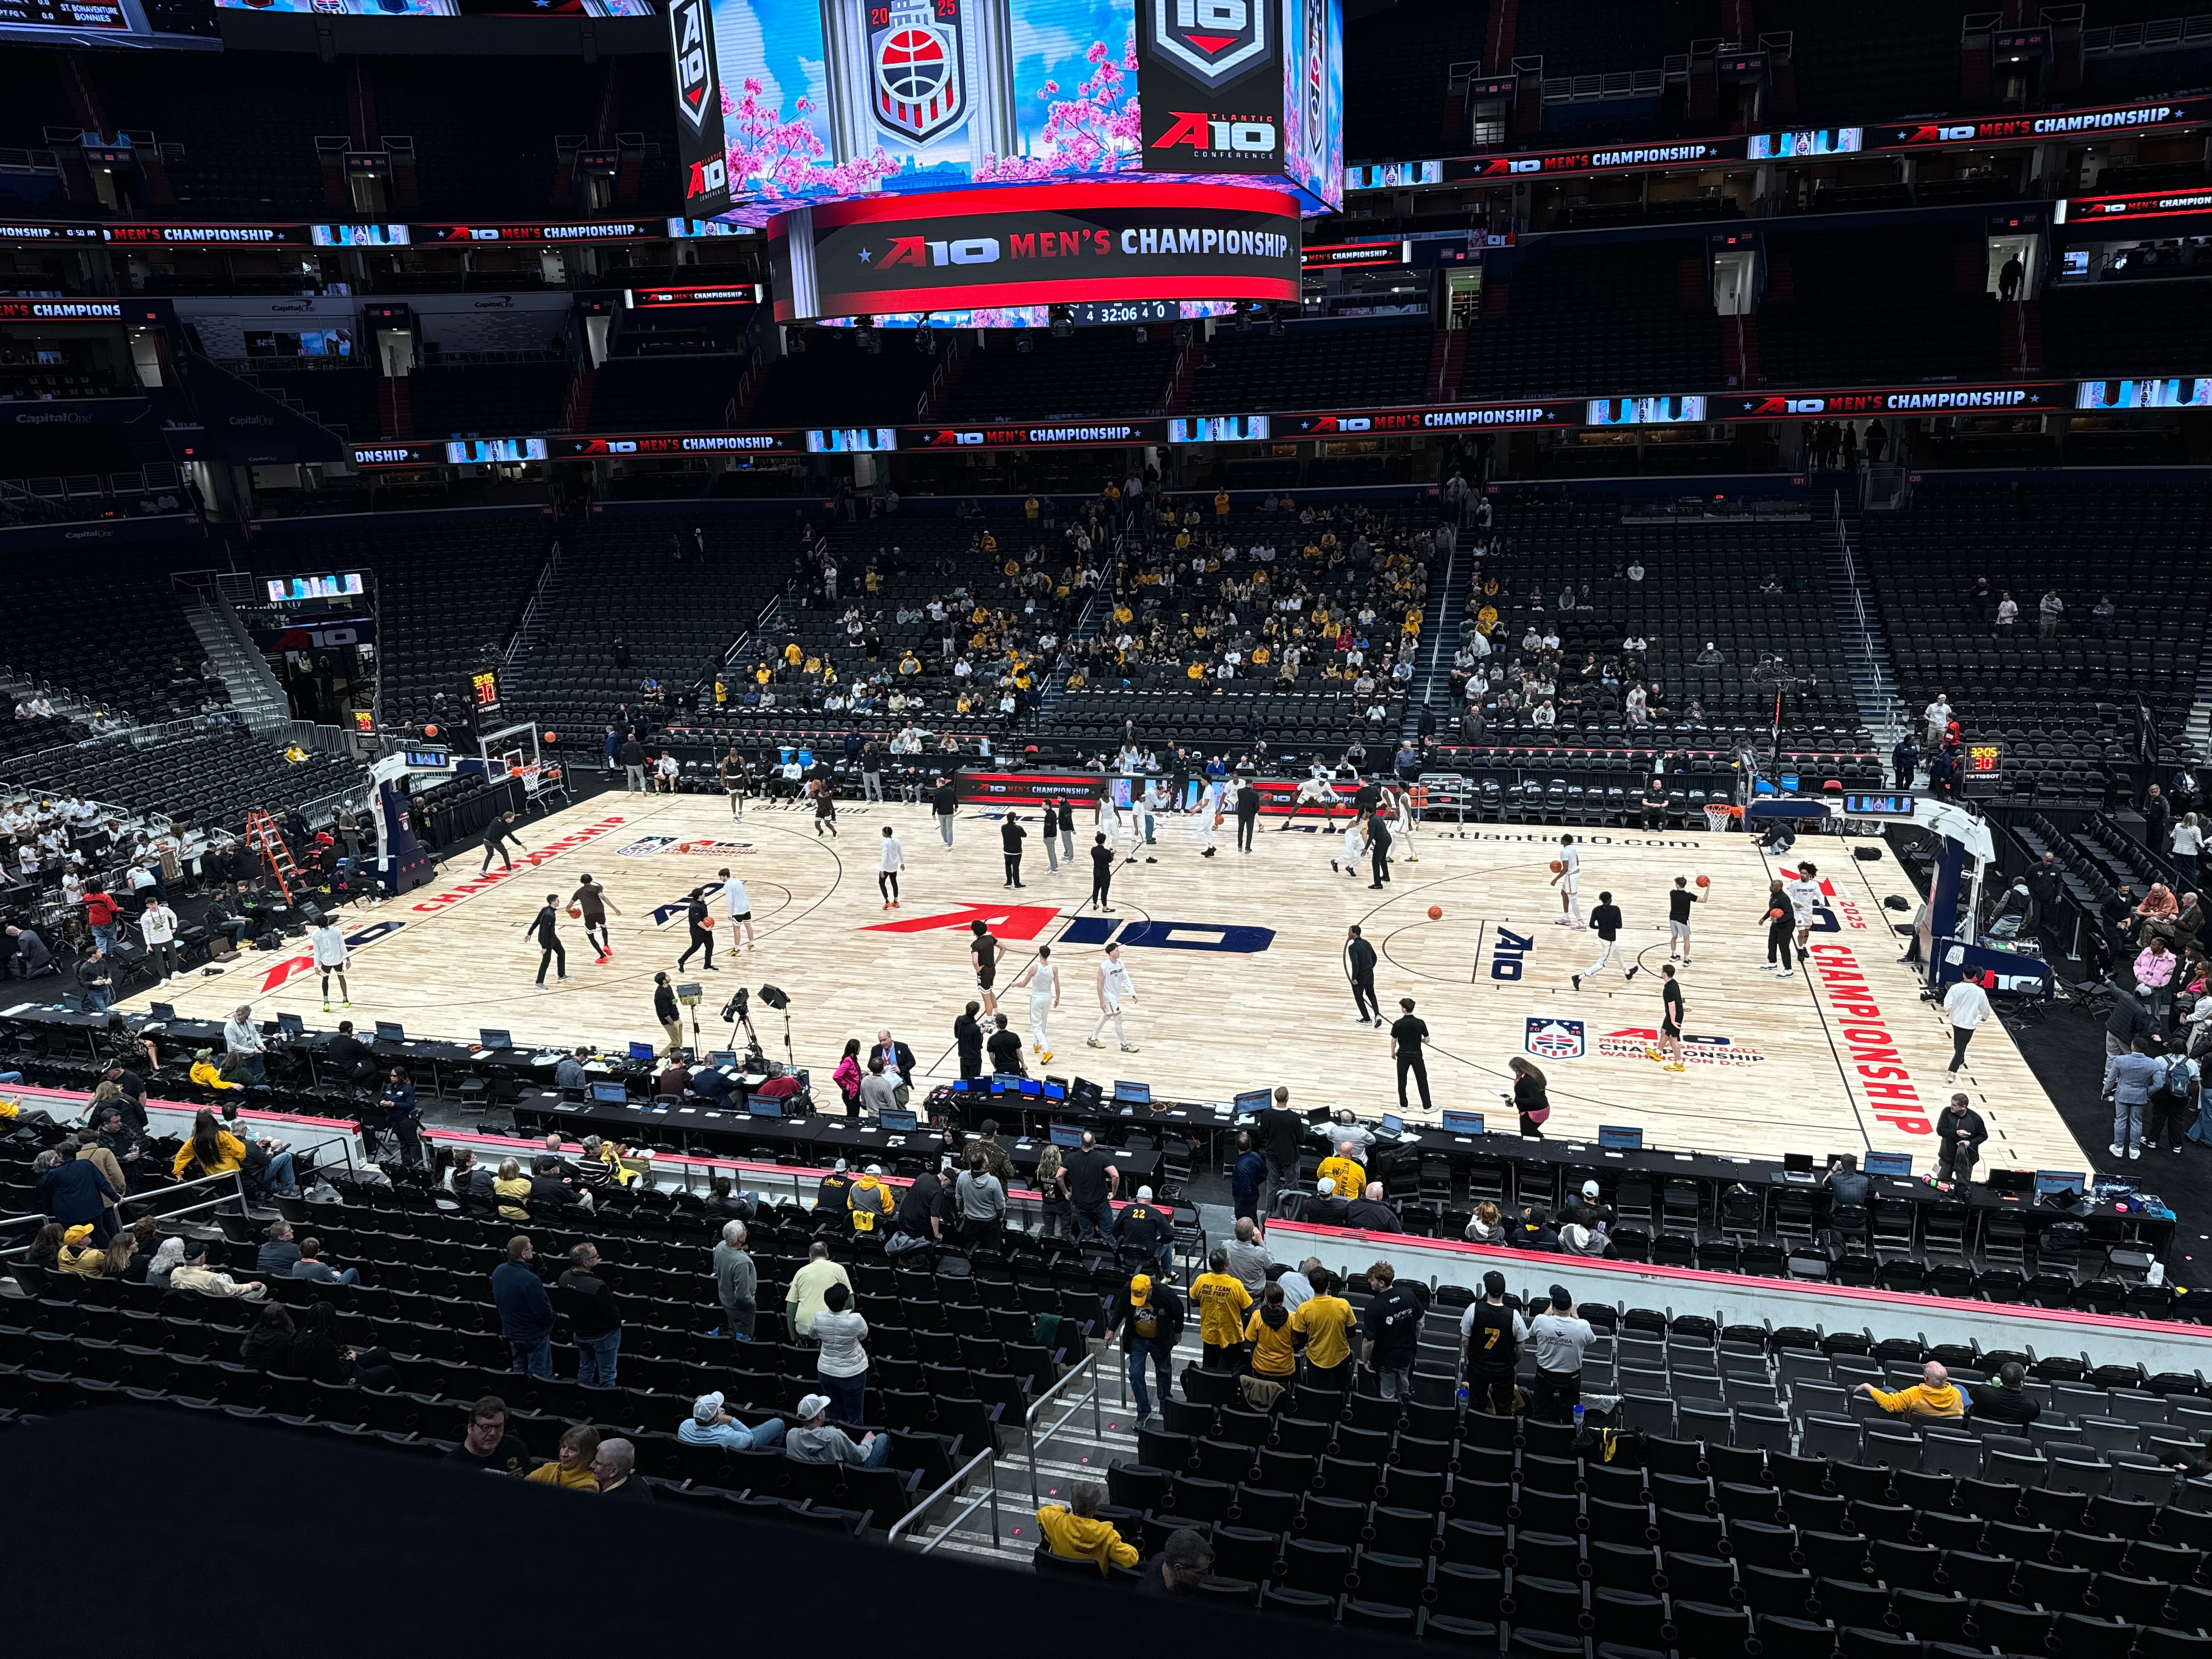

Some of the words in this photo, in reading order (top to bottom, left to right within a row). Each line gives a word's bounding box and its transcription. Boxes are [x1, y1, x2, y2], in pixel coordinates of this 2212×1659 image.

[60, 3, 72, 12] ST.
[72, 4, 119, 15] BONAVENTURE
[872, 8, 887, 25] 20
[938, 0, 955, 16] 25
[74, 13, 112, 22] BONNIES
[1150, 111, 1275, 151] A10
[1908, 126, 1975, 142] A10
[1978, 121, 2030, 137] MEN'S
[2034, 108, 2170, 133] CHAMPIONSHIP
[1194, 151, 1273, 159] CONFERENCE
[1481, 160, 1541, 175] A10
[1544, 155, 1589, 170] MEN'S
[1593, 145, 1706, 166] CHAMPIONSHIP
[687, 159, 725, 199] A10
[699, 187, 726, 202] CONFERENCE
[2086, 204, 2126, 213] A10
[2128, 201, 2158, 210] MEN'S
[114, 229, 161, 240] MEN'S
[165, 228, 274, 241] CHAMPIONSHIP
[445, 227, 499, 240] A10
[502, 227, 541, 239] MEN'S
[544, 224, 635, 238] CHAMPIONSHIP
[873, 235, 1000, 270] A10
[1009, 229, 1111, 260] MEN'S
[1121, 227, 1288, 259] CHAMPIONSHIP
[1309, 253, 1331, 262] MEN'S
[1332, 250, 1387, 260] CHAMPIONSHIP
[694, 291, 743, 300] CHAMPIONSHIP
[33, 304, 121, 317] CHAMPIONS
[1086, 311, 1093, 321] 4
[1101, 307, 1137, 322] 32:06
[1142, 308, 1149, 318] 4
[1156, 304, 1165, 318] 0
[1756, 397, 1824, 414] A10
[1828, 396, 1883, 413] MEN'S
[1887, 390, 2025, 409] CHAMPIONSHIP
[1310, 417, 1370, 432] A10
[1374, 414, 1421, 428] MEN'S
[1425, 408, 1543, 427] CHAMPIONSHIP
[930, 430, 983, 445] A10
[986, 430, 1026, 443] MEN'S
[1029, 426, 1130, 442] CHAMPIONSHIP
[583, 440, 636, 454] A10
[639, 438, 680, 451] MEN'S
[682, 436, 774, 450] CHAMPIONSHIP
[355, 449, 408, 462] ONSHIP
[271, 628, 358, 652] A10
[473, 673, 495, 687] 32:05
[477, 684, 495, 705] 30
[484, 704, 501, 712] TISSOT
[355, 712, 371, 721] 32:05
[360, 720, 371, 730] 30
[1971, 747, 1998, 758] 32:05
[1975, 758, 1993, 770] 30
[977, 783, 1006, 792] A10
[1032, 786, 1090, 795] CHAMPIONSHIP
[1260, 793, 1291, 802] A10
[752, 805, 870, 814] @A10BB
[1437, 832, 1700, 848] atlantic10.com
[1839, 901, 1867, 929] 2025
[856, 901, 1277, 953] A10
[1491, 926, 1534, 981] A10
[1599, 1037, 1648, 1046] MEN'S
[1602, 1028, 1731, 1045] A0
[1810, 944, 1934, 1135] CHAMPIONSHIP
[1598, 1043, 1765, 1062] CHAPONSHIP
[1600, 1050, 1714, 1065] WASHNGTON
[1719, 1059, 1755, 1068] D.C.
[825, 1177, 844, 1186] UNION
[1132, 1209, 1146, 1219] 22
[1394, 1308, 1413, 1319] synergy
[1484, 1327, 1500, 1350] 7
[1545, 1335, 1573, 1344] VIRGINIA
